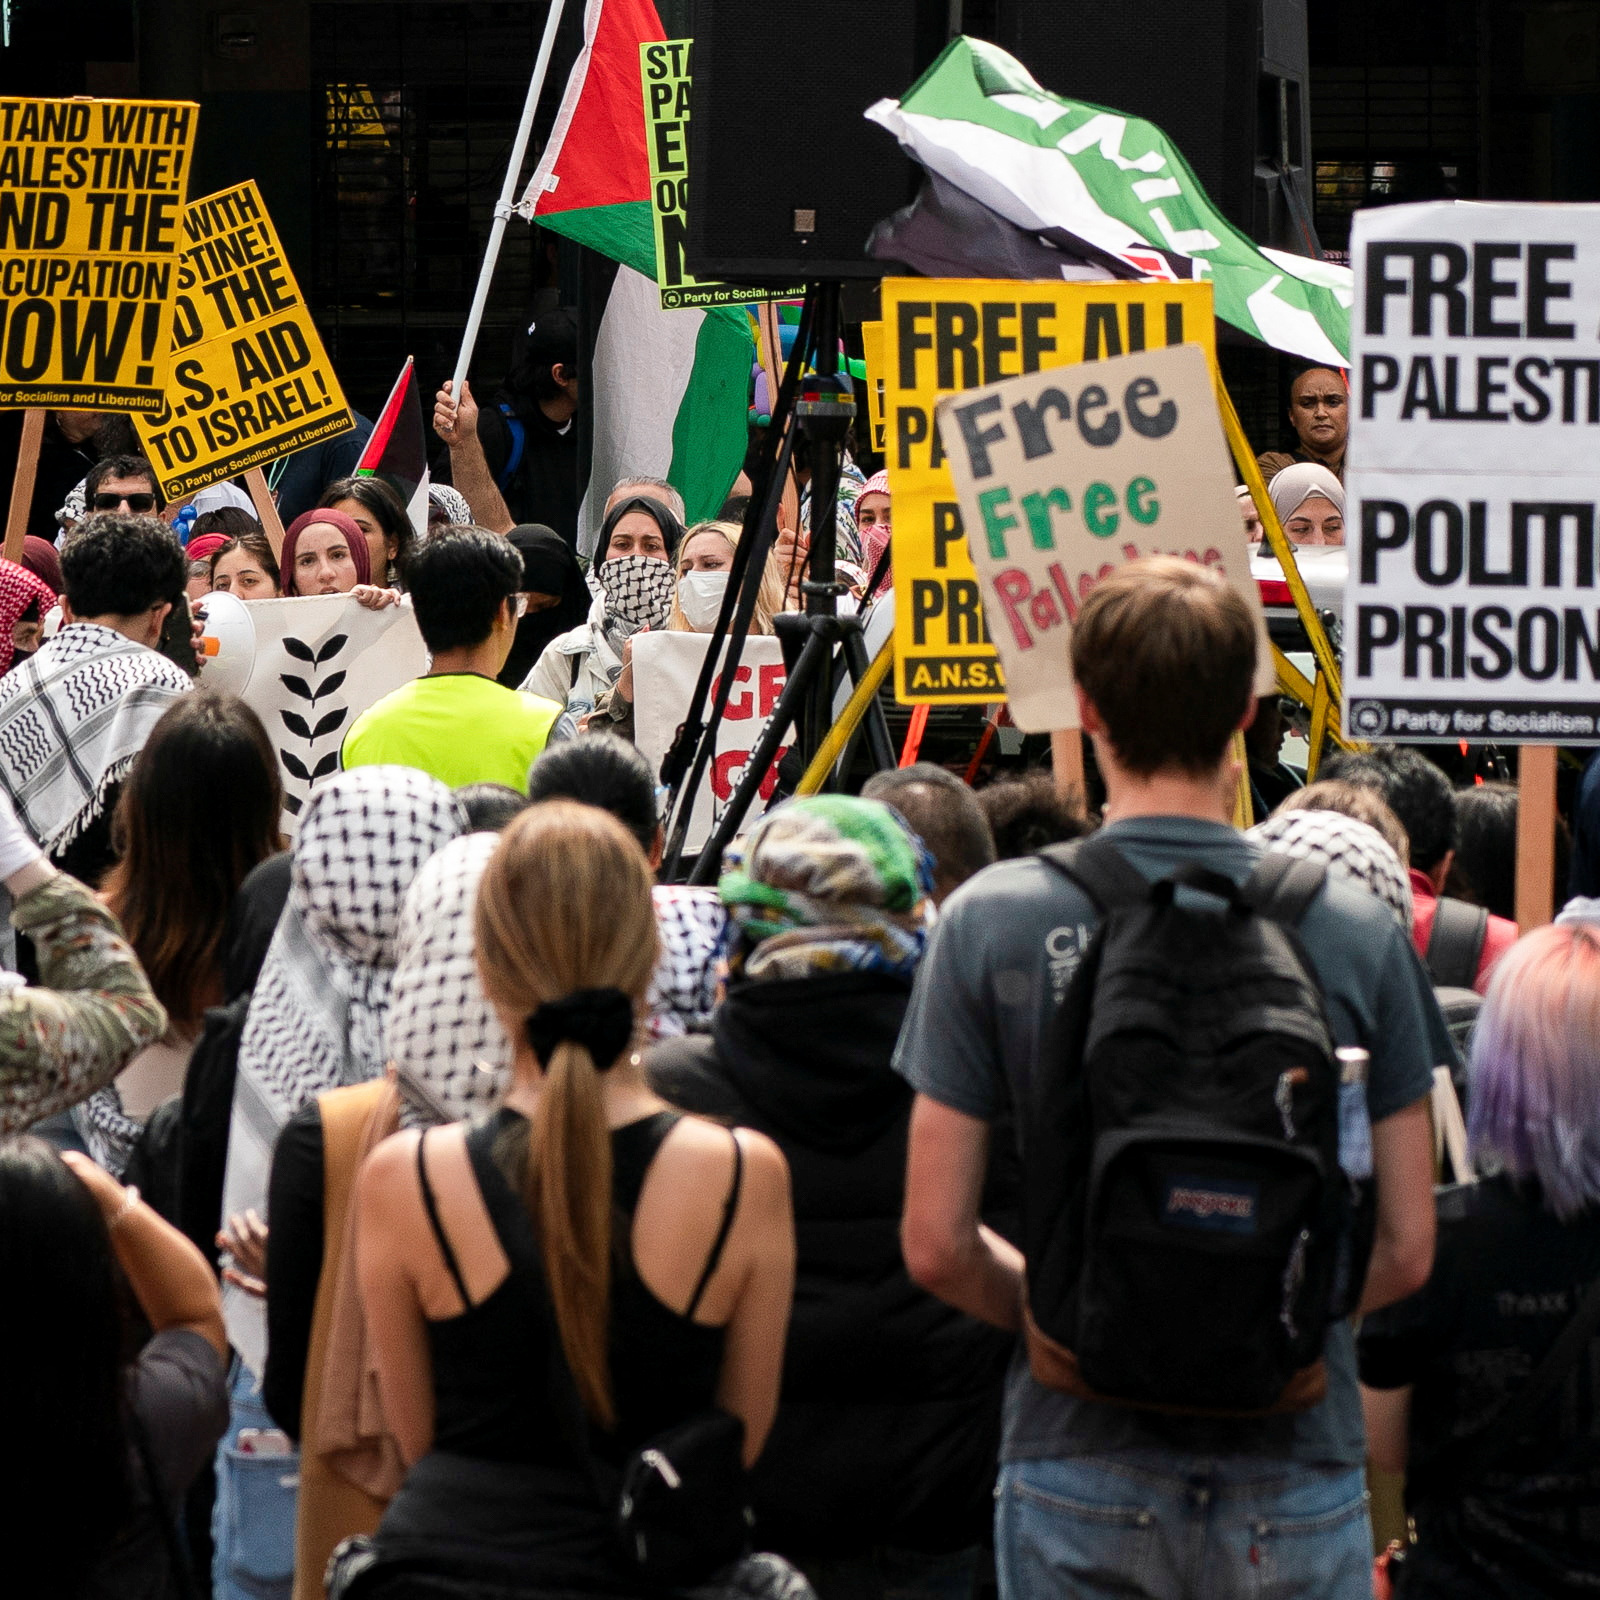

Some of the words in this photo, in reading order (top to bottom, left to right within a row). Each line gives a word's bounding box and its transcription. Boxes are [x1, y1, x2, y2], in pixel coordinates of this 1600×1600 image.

[102, 104, 190, 146] WITH
[85, 192, 181, 253] THE
[183, 186, 262, 244] WITH
[202, 256, 299, 331] THE
[684, 289, 714, 304] Party
[714, 289, 730, 301] for
[1363, 240, 1577, 340] FREE
[230, 319, 312, 393] AID
[896, 300, 1057, 391] FREE
[15, 391, 70, 404] Socialism
[73, 392, 96, 404] and
[98, 393, 160, 408] Liberation
[148, 431, 200, 472] TO
[196, 368, 334, 454] ISRAEL!
[954, 376, 1179, 480] Free
[185, 472, 214, 490] Party
[213, 462, 230, 478] for
[229, 445, 279, 471] Socialism
[279, 436, 299, 452] and
[298, 416, 350, 445] Liberation
[977, 474, 1162, 560] Free
[1392, 706, 1450, 736] Party
[1454, 707, 1486, 732] for
[1487, 708, 1592, 735] Socialism
